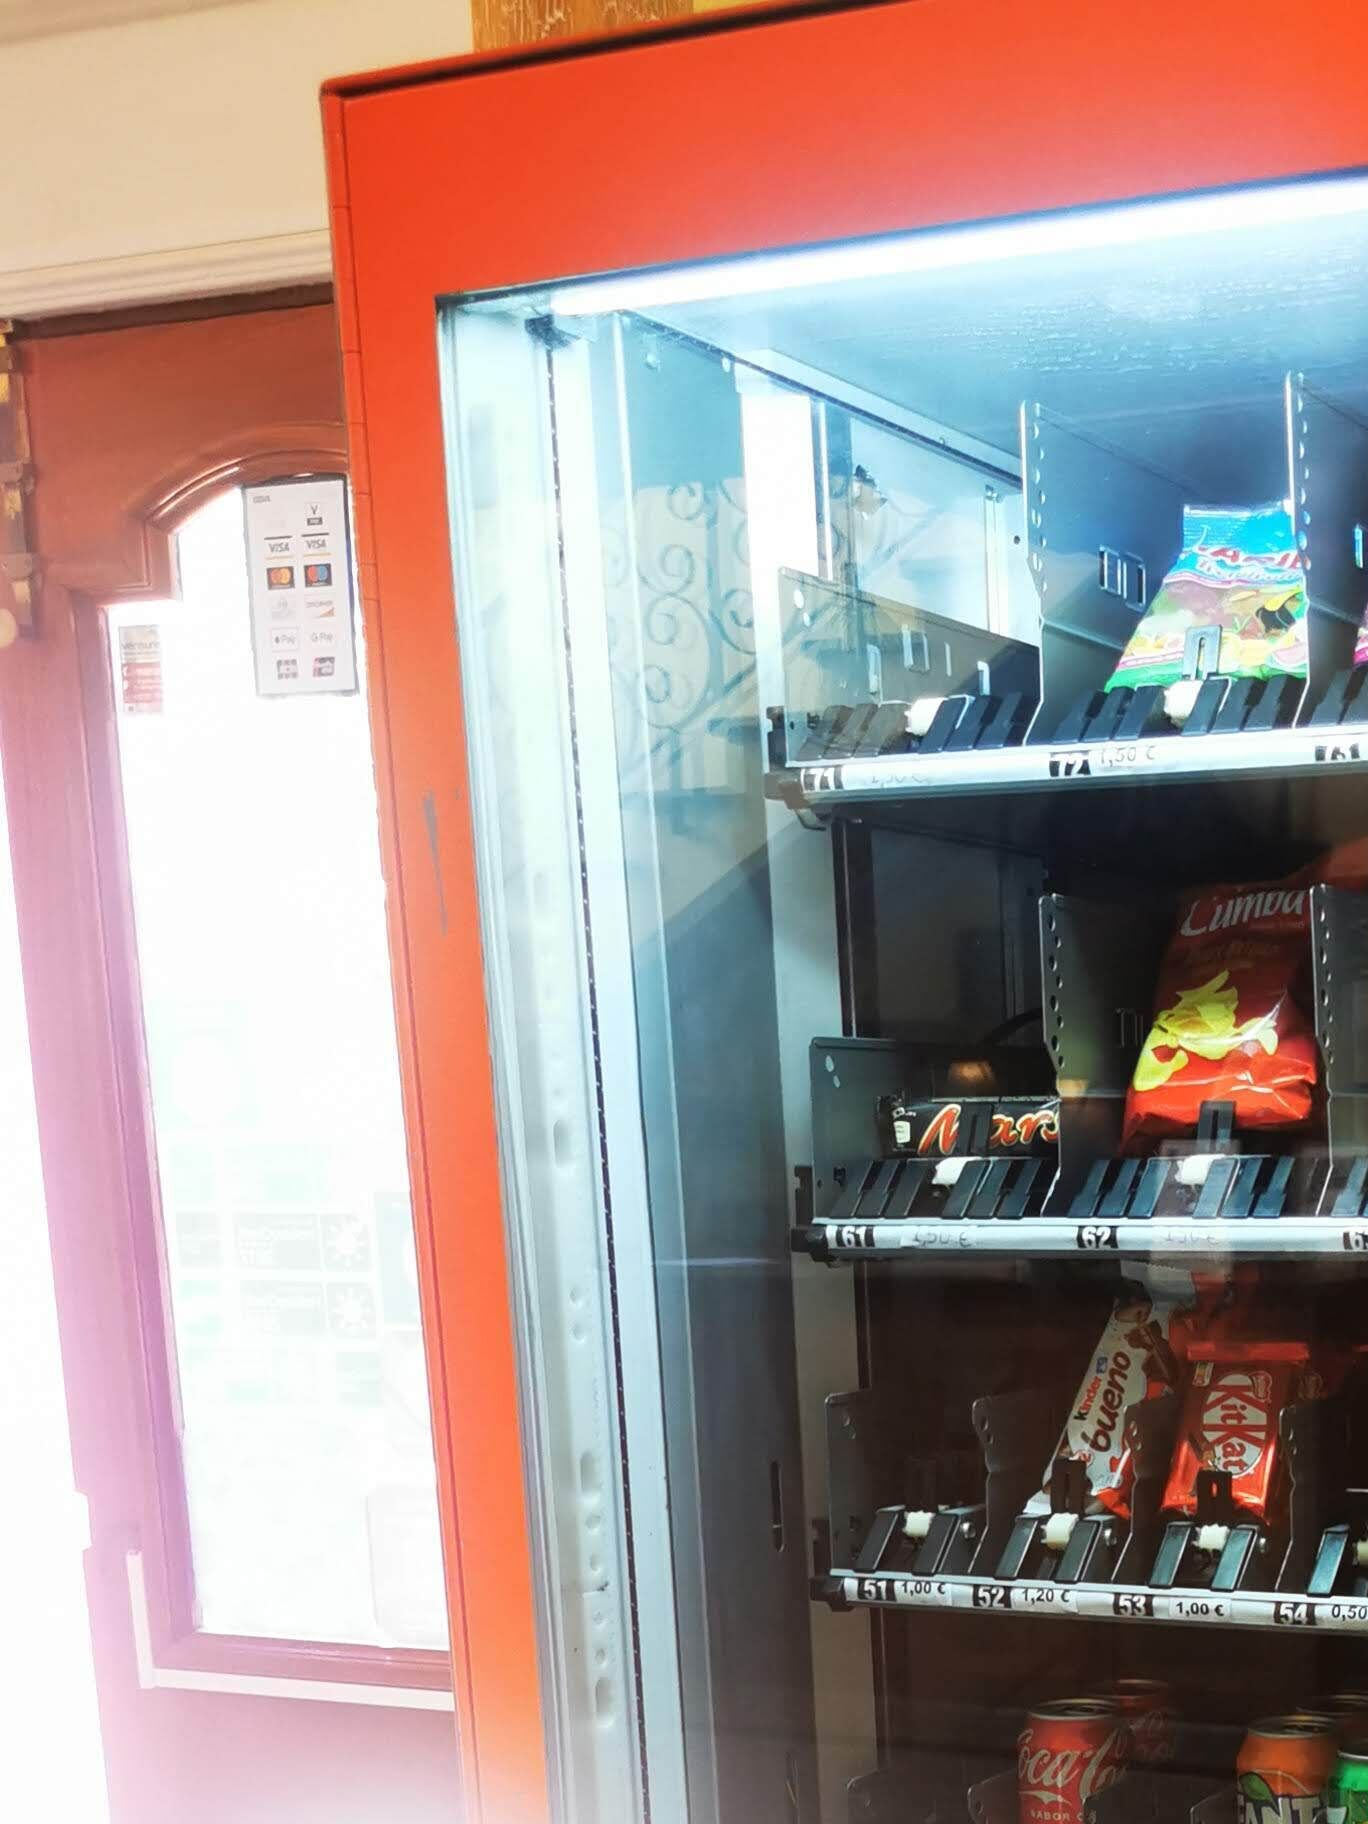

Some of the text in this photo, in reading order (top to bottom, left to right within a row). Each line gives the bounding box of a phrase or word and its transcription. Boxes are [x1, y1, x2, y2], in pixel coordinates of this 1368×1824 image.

[269, 543, 290, 553] VISA
[306, 540, 327, 550] VISA
[1081, 1226, 1112, 1249] 62
[1074, 1374, 1103, 1421] kinder
[1080, 1351, 1132, 1453] bueno
[863, 1580, 932, 1600] 51 1,00
[977, 1586, 1054, 1608] 52 1,20
[1119, 1594, 1225, 1618] 53 1,00 €
[1279, 1603, 1368, 1625] 54 0,50
